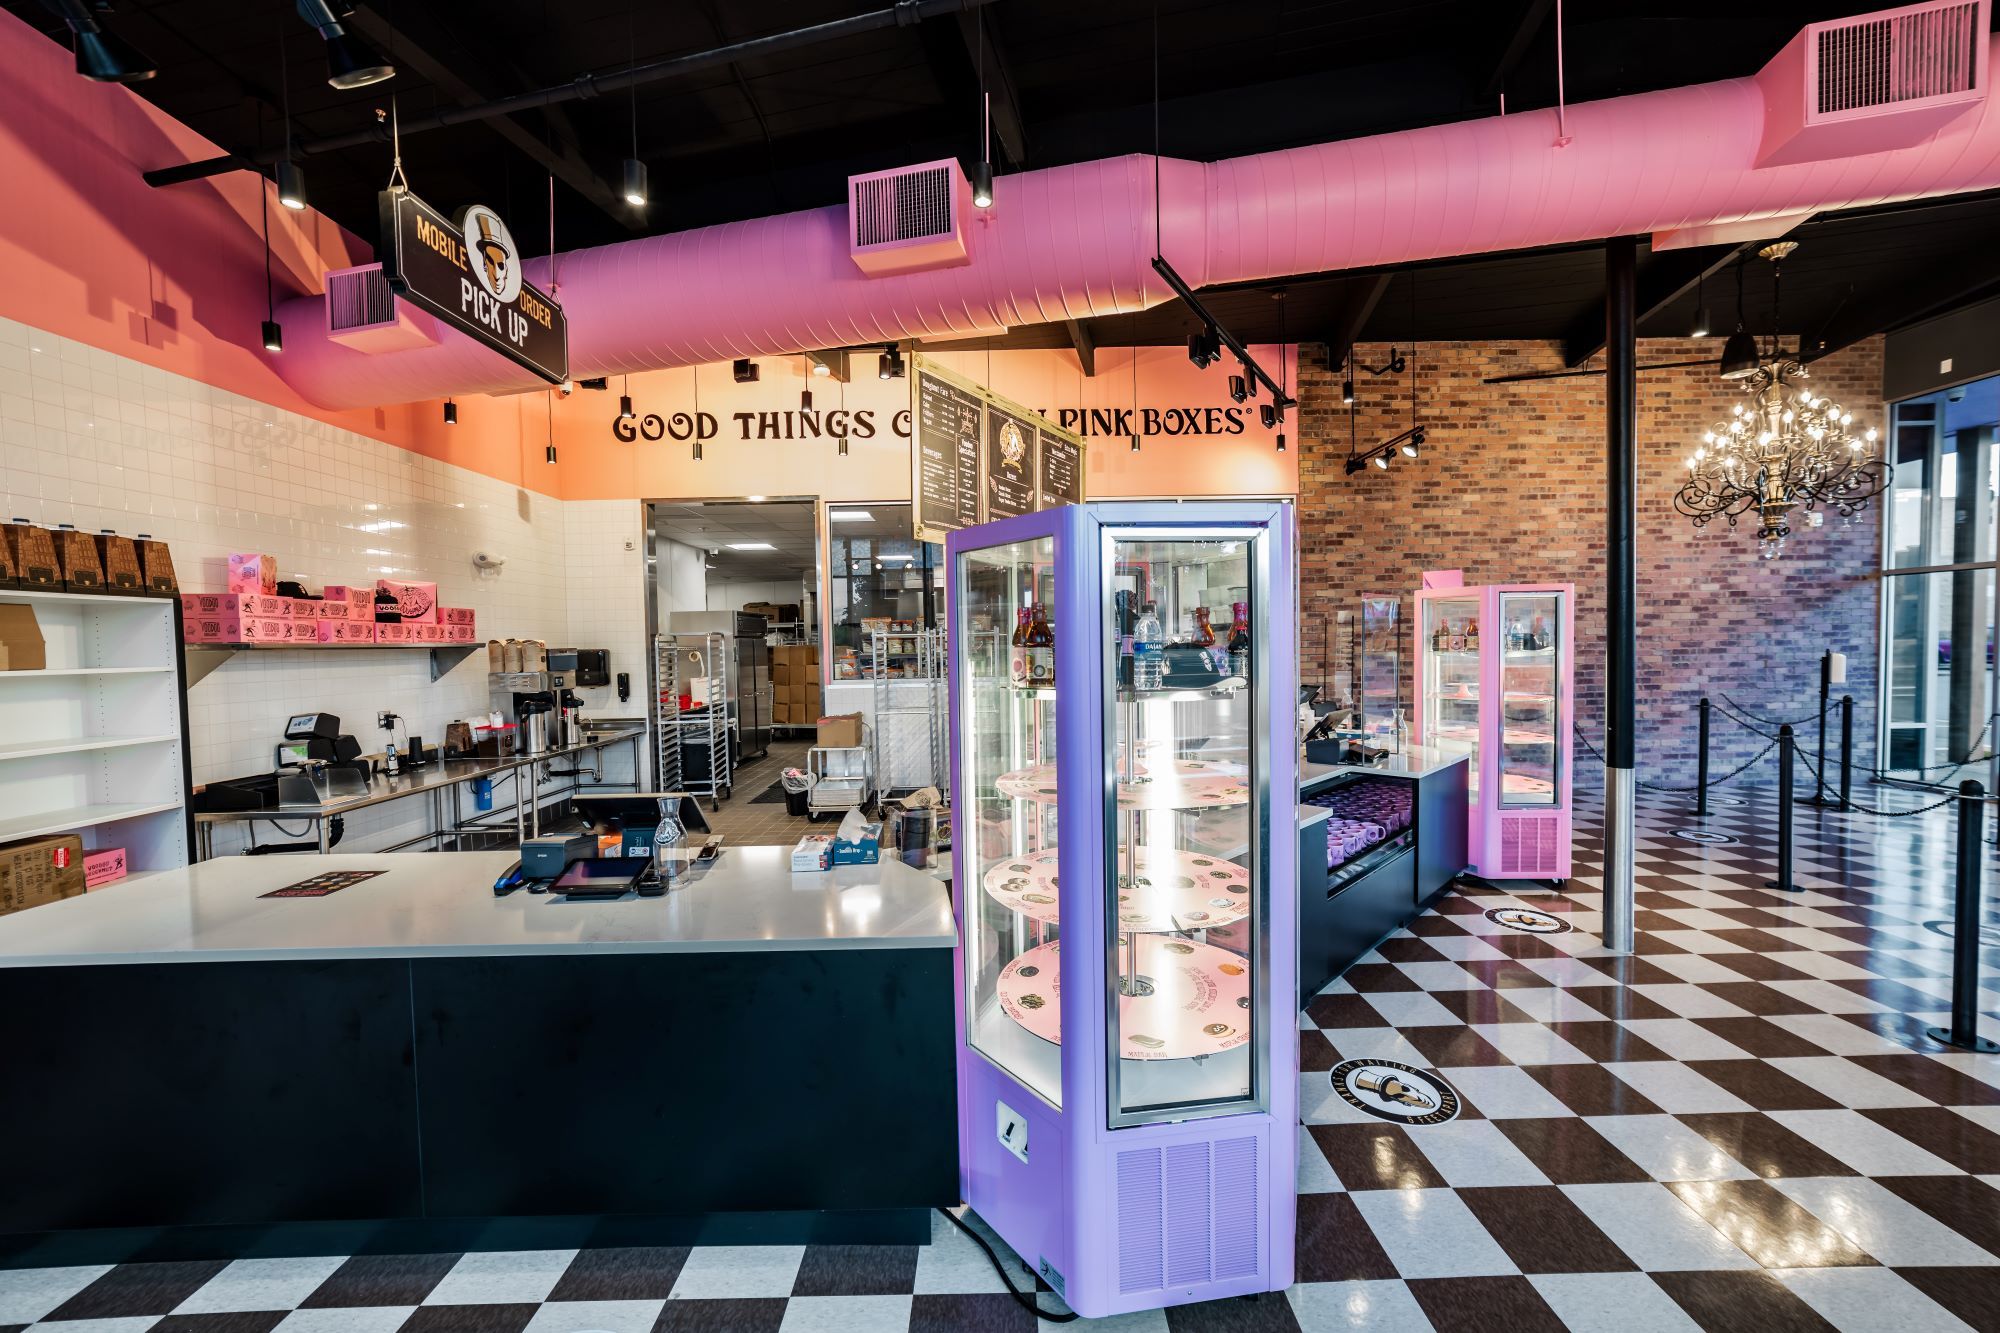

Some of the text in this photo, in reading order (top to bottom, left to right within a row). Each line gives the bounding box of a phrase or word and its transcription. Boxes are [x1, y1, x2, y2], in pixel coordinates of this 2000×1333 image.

[416, 215, 552, 330] MOBILE ORDER
[460, 278, 529, 347] PICK UP
[612, 412, 719, 443] GOOD
[733, 410, 876, 440] THINGS
[1058, 408, 1134, 437] PINK
[1355, 1059, 1417, 1074] WAITING
[1417, 1111, 1448, 1125] FEET
[1440, 1090, 1456, 1115] APART
